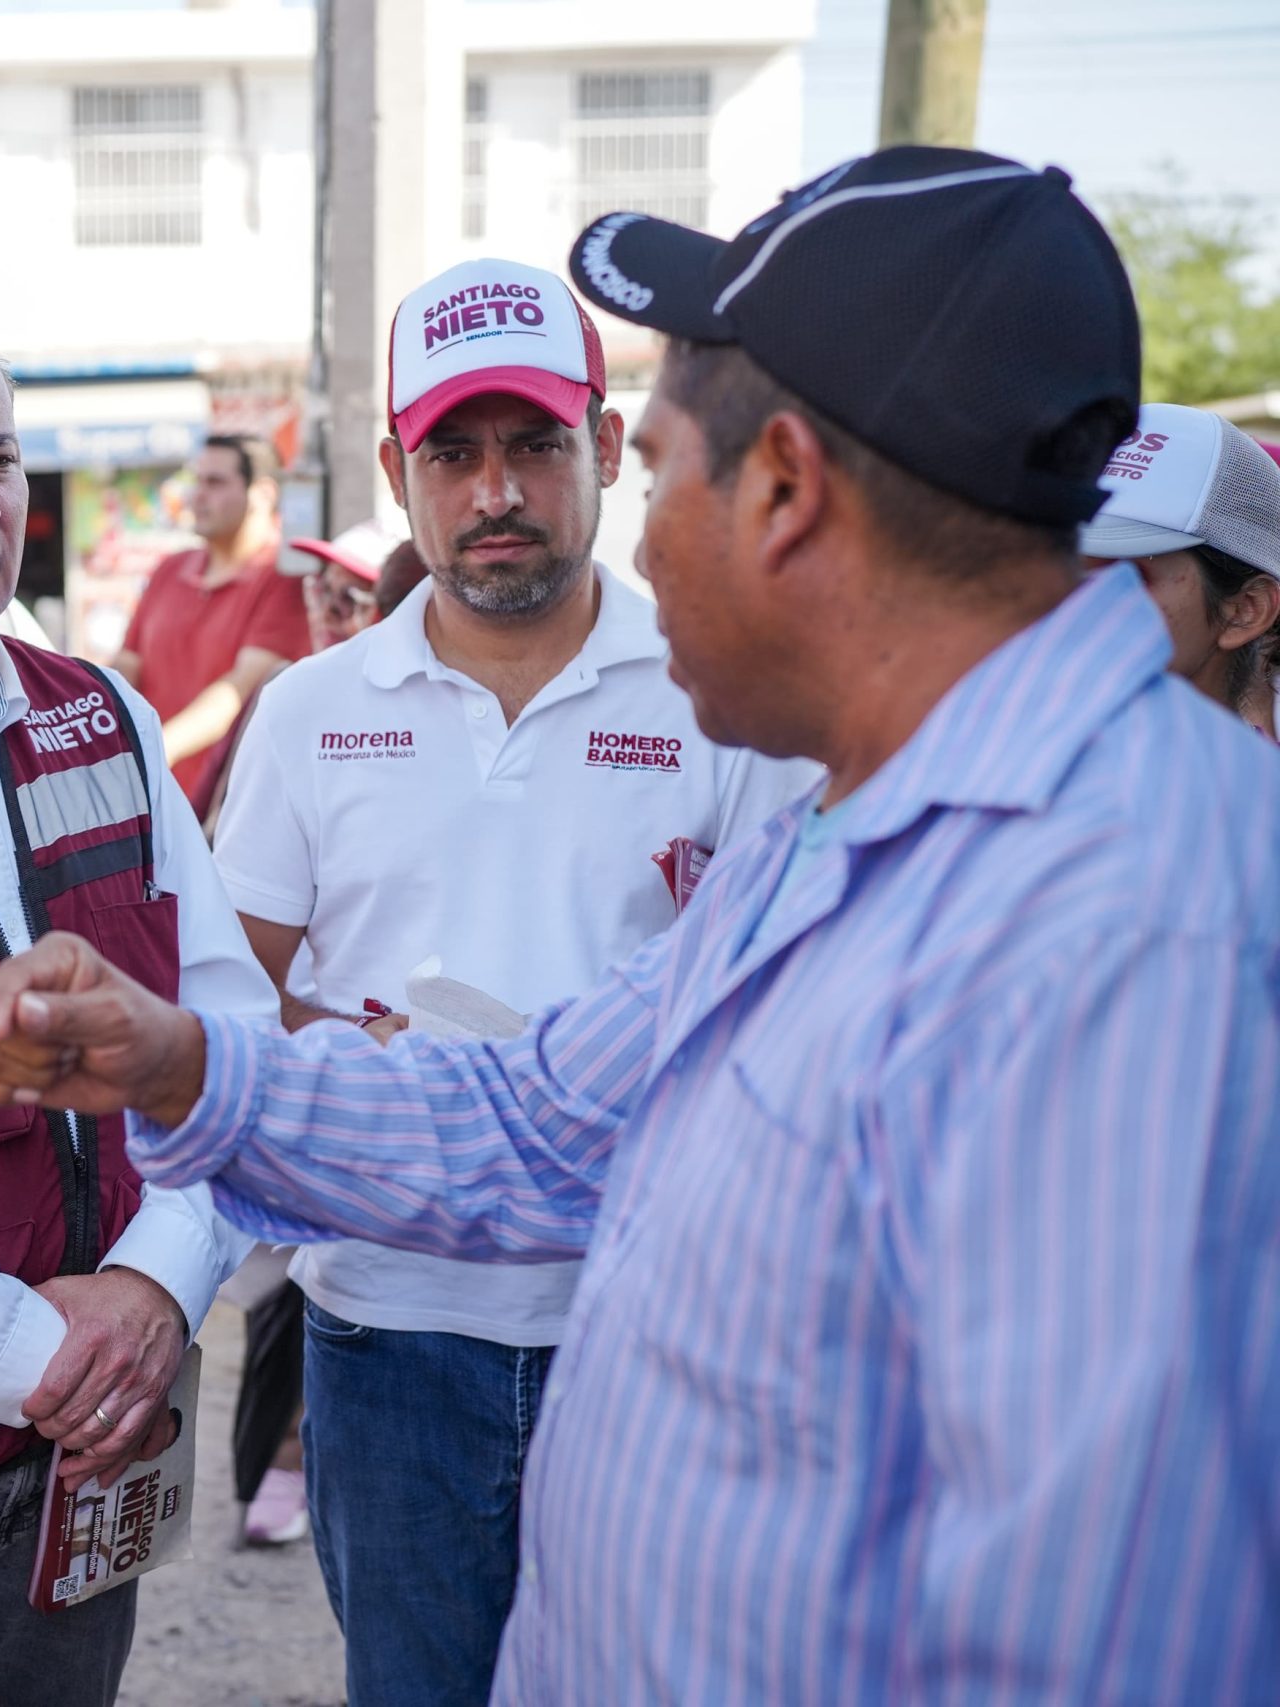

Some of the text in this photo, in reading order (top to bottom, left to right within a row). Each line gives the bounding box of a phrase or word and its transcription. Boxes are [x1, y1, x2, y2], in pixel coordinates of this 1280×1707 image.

[423, 283, 540, 324] SANTIAGO
[424, 300, 544, 351] NIETO
[465, 330, 503, 341] SENADOR
[22, 691, 104, 726] SANTIAGO
[27, 708, 117, 754] NIETO
[321, 730, 413, 750] morena
[589, 730, 682, 752] HOMERO
[318, 749, 416, 762] La esperanza de México
[587, 748, 680, 768] BARRERA
[95, 1503, 104, 1513] El
[136, 1468, 161, 1562] SANTIAGO
[163, 1487, 177, 1517] VOTA
[92, 1512, 103, 1541] cambio
[113, 1474, 149, 1573] NIETO
